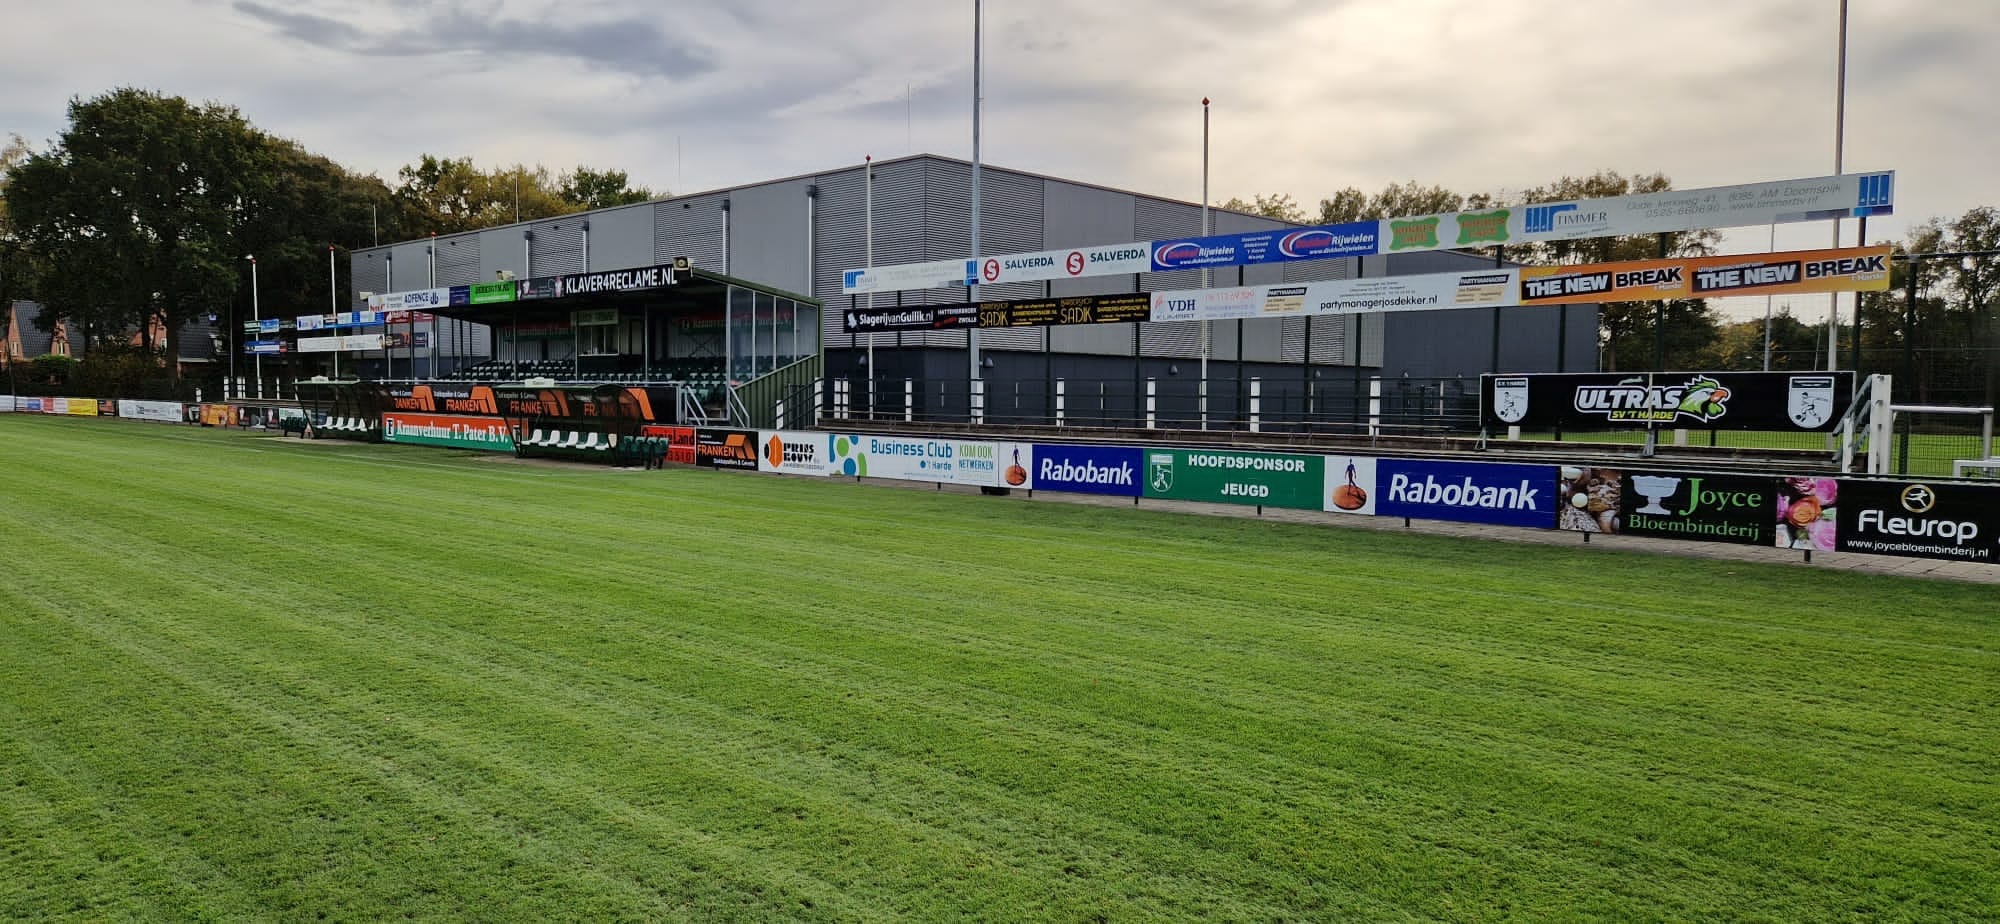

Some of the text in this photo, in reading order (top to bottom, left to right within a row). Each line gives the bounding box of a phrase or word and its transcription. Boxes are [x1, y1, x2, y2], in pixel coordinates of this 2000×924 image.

[1760, 189, 1779, 199] AM
[1558, 212, 1607, 226] TIMMER
[1331, 233, 1374, 246] Rijwielen
[1090, 248, 1146, 263] SALVERDA
[1198, 246, 1234, 258] Rijwielen
[1004, 256, 1055, 270] SALVERDA
[1697, 255, 1886, 289] THE NEW BREAK
[565, 267, 678, 295] KLAVER4RECLAME.NL
[1526, 266, 1684, 297] THE NEW BREAK
[1167, 299, 1196, 312] VDH
[1320, 294, 1438, 312] partymanagerjosdekker.nl
[859, 310, 934, 327] SlagerijvanGullik.nl
[958, 316, 977, 324] ZWOLLE
[446, 399, 480, 411] FRANKEN
[1576, 387, 1682, 411] ULTRAS
[1612, 411, 1626, 420] SV
[1637, 410, 1675, 421] HARDE
[396, 419, 509, 443] Kraanverhuur T. Pater B.V.
[696, 444, 736, 458] FRANKEN
[871, 438, 953, 459] Business Club
[959, 443, 993, 459] KOM OOK
[932, 460, 952, 471] Harde
[959, 459, 994, 471] NETWERKEN
[1040, 457, 1133, 486] Rabobank
[1188, 454, 1306, 473] HOOFDSPONSOR
[1220, 482, 1270, 498] JEUGD
[1388, 473, 1539, 511] Rabobank
[1678, 478, 1763, 516] Joyce
[1628, 513, 1761, 543] Bloembinderij
[1858, 509, 1979, 546] Fleurop
[1846, 538, 1990, 559] www.joycebloembinderij.nl
